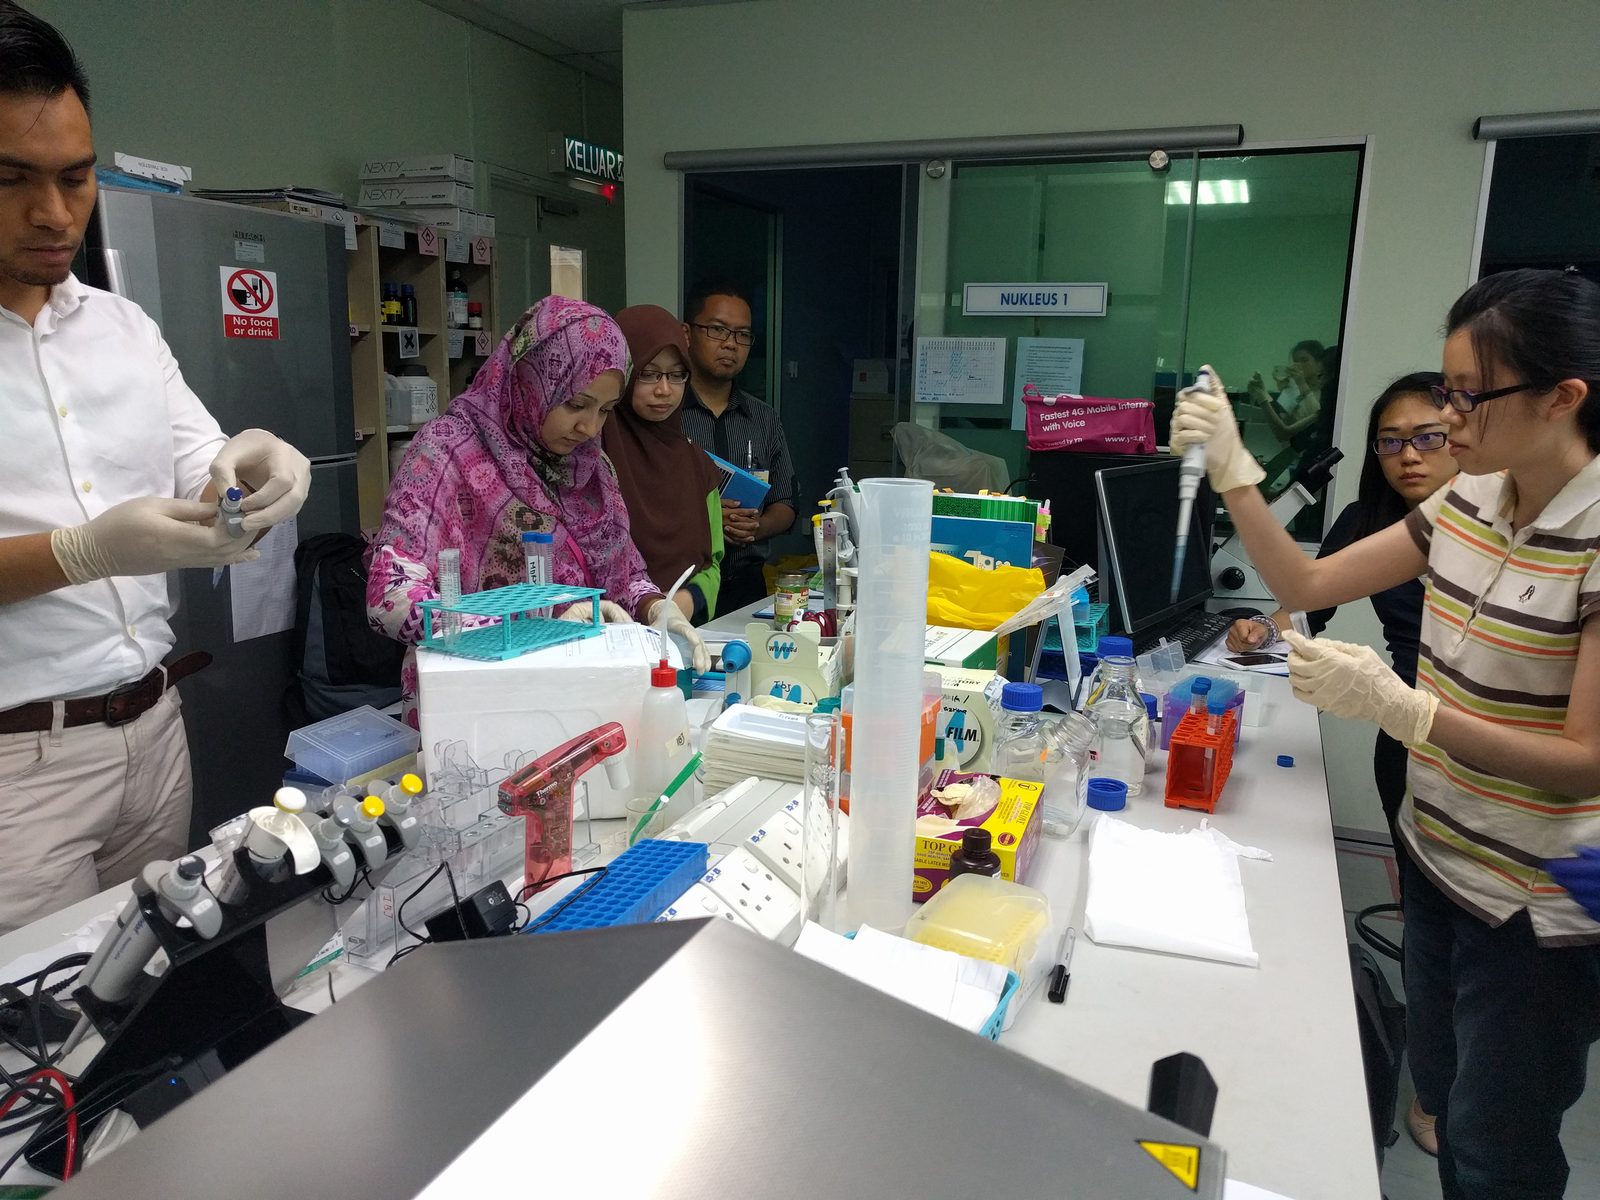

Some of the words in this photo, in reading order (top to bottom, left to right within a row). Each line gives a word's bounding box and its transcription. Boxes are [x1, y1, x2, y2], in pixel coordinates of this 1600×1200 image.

[565, 138, 615, 180] KELUAR
[1000, 292, 1058, 306] NUKLEUS
[1063, 293, 1068, 306] 1
[233, 316, 247, 326] No
[250, 317, 273, 327] food
[247, 327, 273, 337] drink
[1040, 410, 1070, 421] Fastest
[1071, 408, 1085, 417] 4G
[1086, 404, 1117, 414] Mobile
[1042, 422, 1061, 432] with
[1063, 419, 1086, 429] Voice
[946, 726, 978, 742] FILM
[535, 781, 558, 798] Thermo
[922, 840, 946, 851] TOP
